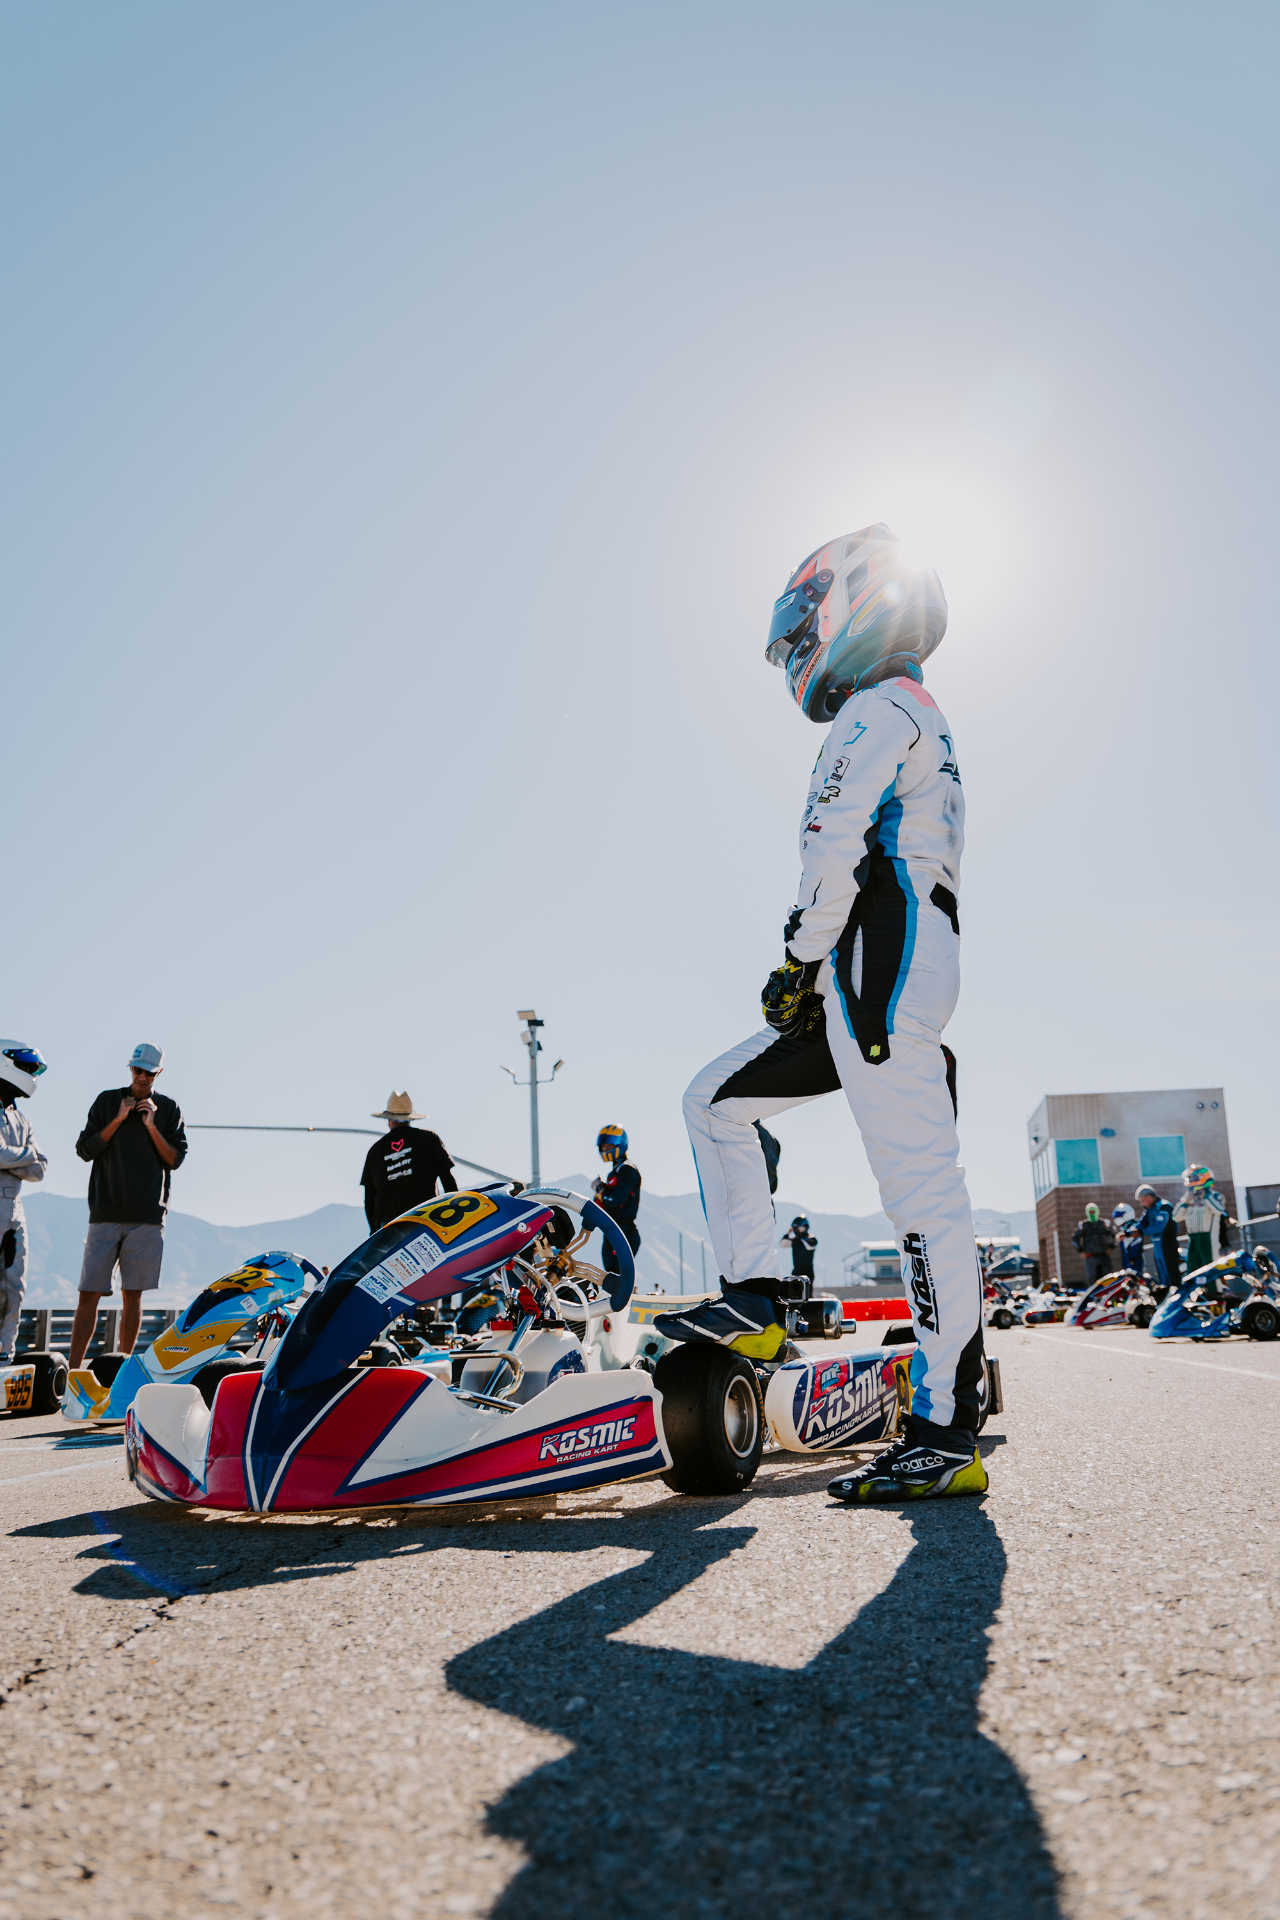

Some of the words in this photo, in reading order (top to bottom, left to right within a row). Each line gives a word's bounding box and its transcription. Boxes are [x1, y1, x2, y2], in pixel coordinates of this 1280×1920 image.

[219, 1269, 263, 1288] 22
[7, 1374, 32, 1408] 985
[805, 1360, 888, 1440] KOSMIC
[538, 1415, 637, 1461] KOSMIC
[820, 1419, 858, 1443] RACING
[854, 1400, 881, 1425] KART
[556, 1448, 592, 1464] RACING
[593, 1443, 620, 1456] KART
[891, 1455, 944, 1473] sparco
